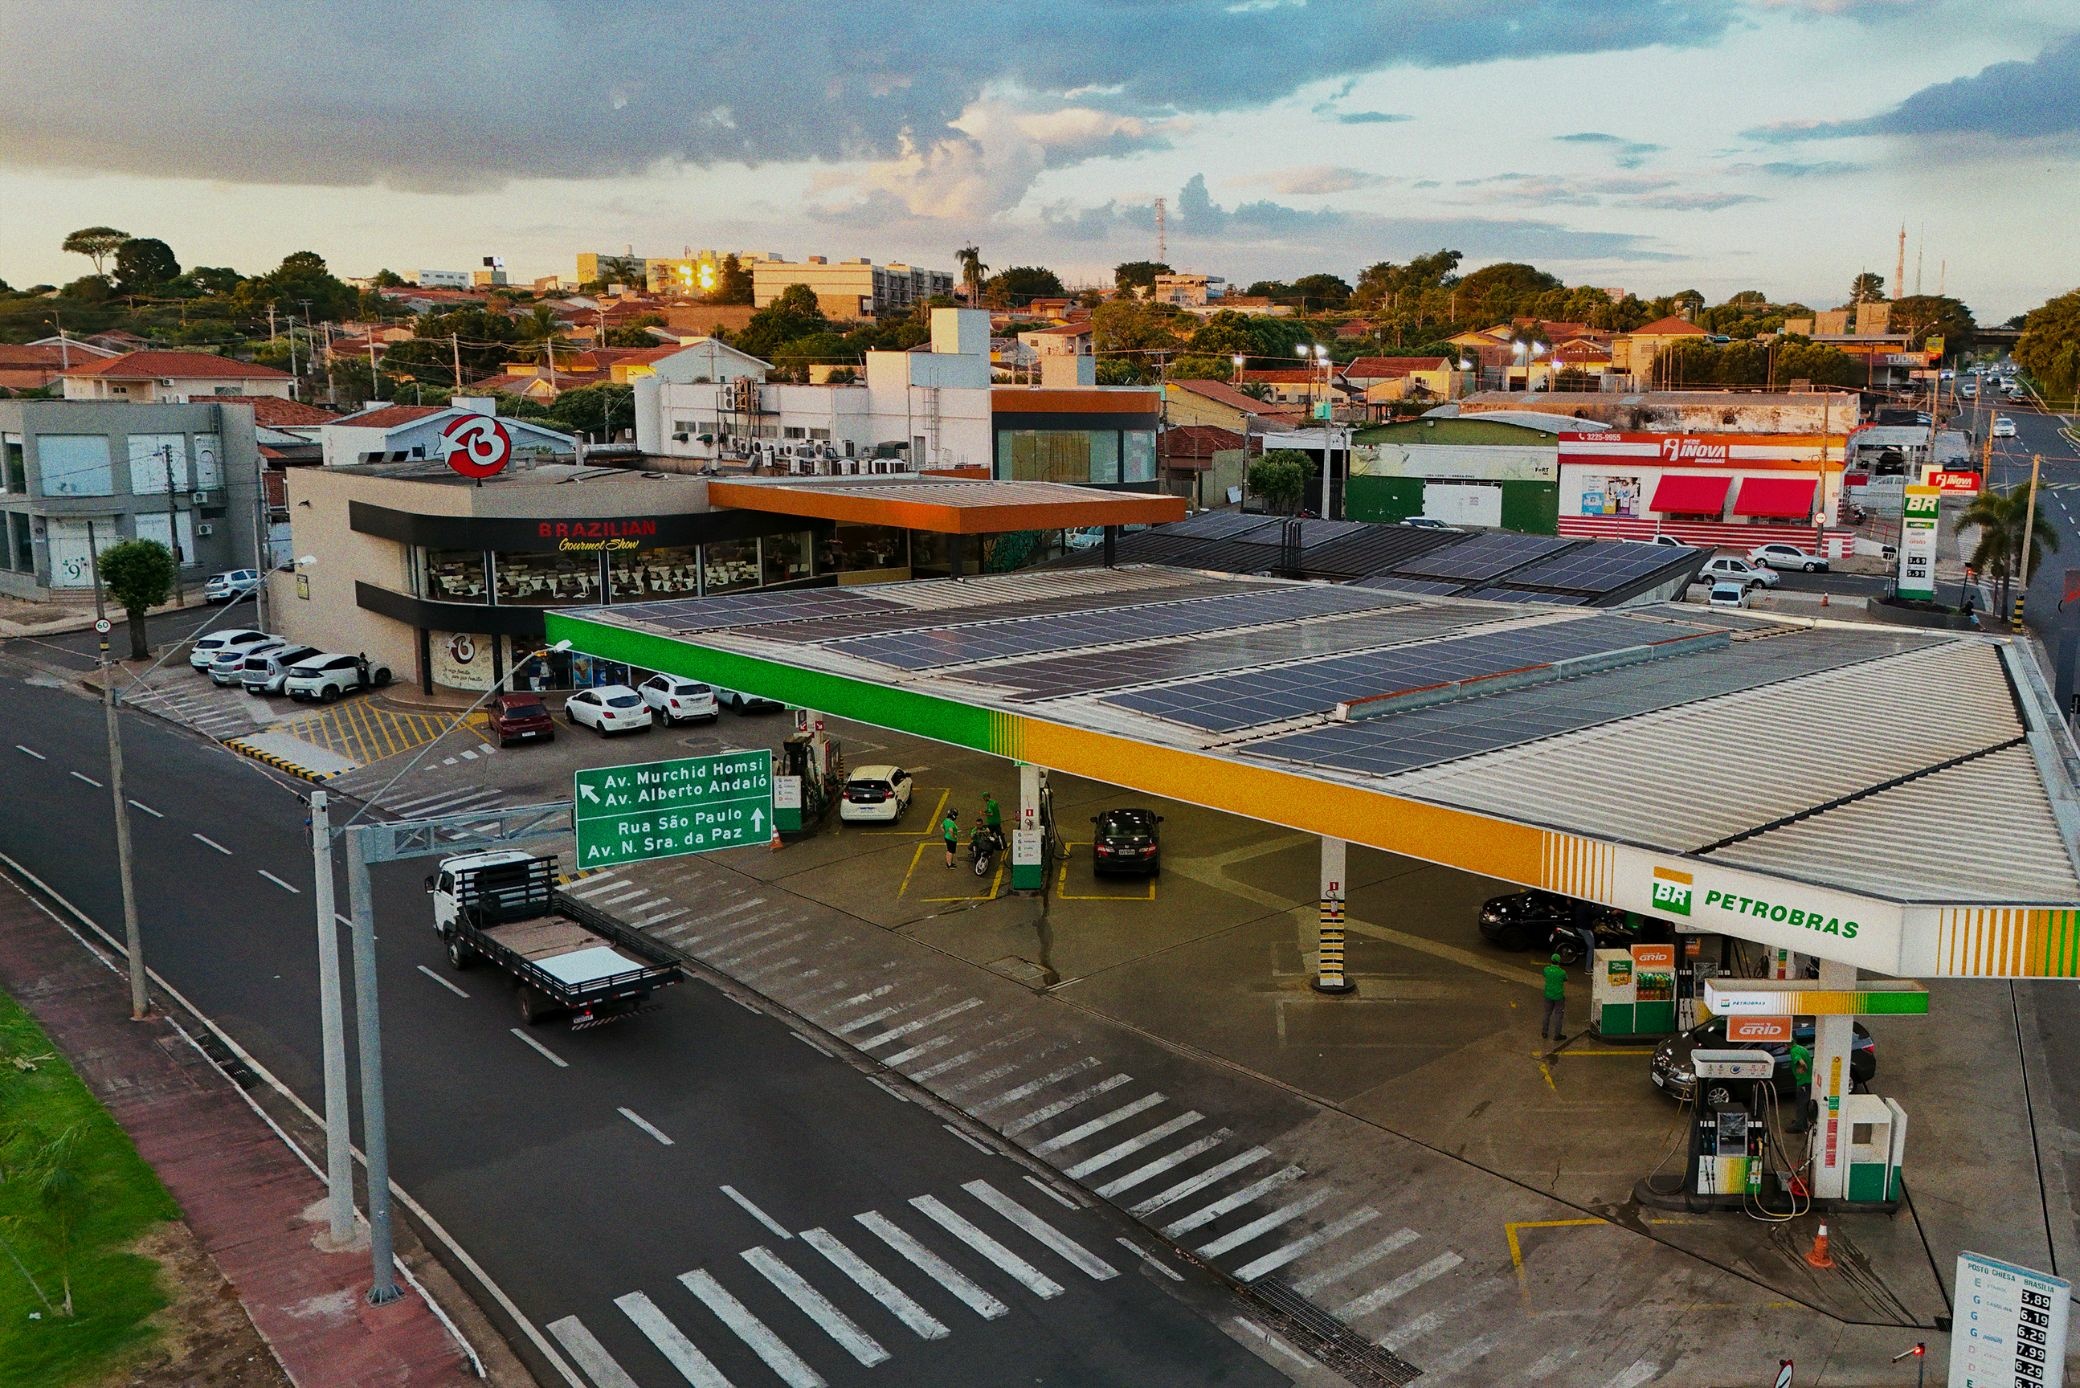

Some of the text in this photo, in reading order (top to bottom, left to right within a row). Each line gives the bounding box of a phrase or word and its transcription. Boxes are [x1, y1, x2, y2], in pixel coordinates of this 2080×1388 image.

[1886, 354, 1924, 363] TUDOR
[1680, 444, 1726, 458] INOVA
[1906, 497, 1937, 512] BR
[538, 521, 656, 538] BRAZILIAN
[559, 538, 639, 551] Gourmet Show
[97, 621, 109, 630] 60
[605, 758, 763, 789] Av. Murchid Homsi
[605, 793, 632, 807] Av.
[638, 784, 702, 803] Alberto
[708, 774, 767, 794] Andaló
[619, 808, 742, 836] Rua São Paulo
[587, 826, 742, 860] Av. N. Sra. da Paz
[1654, 885, 1860, 940] BR PETROBRAS
[1968, 1263, 1989, 1275] POSTO
[1974, 1278, 1982, 1288] E
[1973, 1295, 1981, 1305] G
[1970, 1311, 1978, 1321] G
[1970, 1328, 1978, 1337] G
[1968, 1345, 1976, 1354] D
